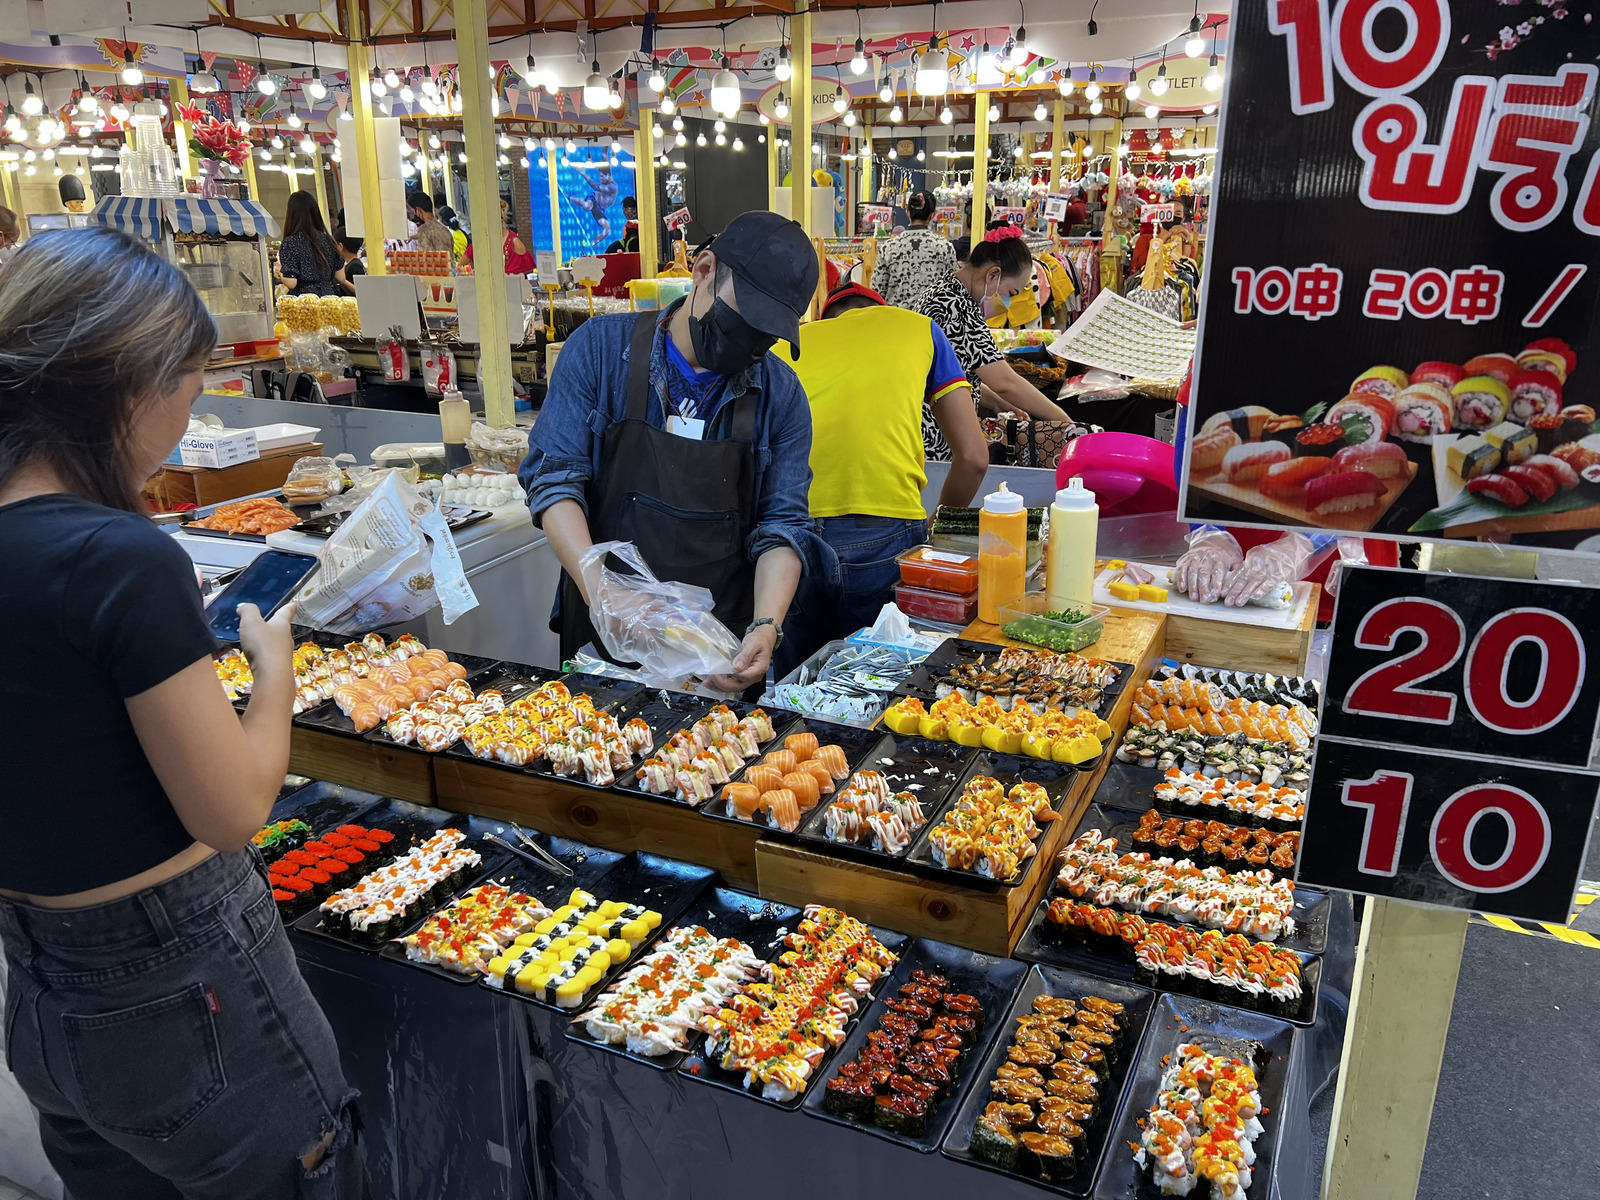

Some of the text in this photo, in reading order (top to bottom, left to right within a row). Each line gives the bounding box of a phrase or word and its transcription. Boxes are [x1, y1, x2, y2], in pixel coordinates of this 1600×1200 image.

[812, 93, 836, 105] KIDS
[1268, 0, 1452, 115] 10
[180, 439, 214, 450] Hi-Glove
[1342, 596, 1586, 735] 20
[1341, 770, 1552, 894] 10
